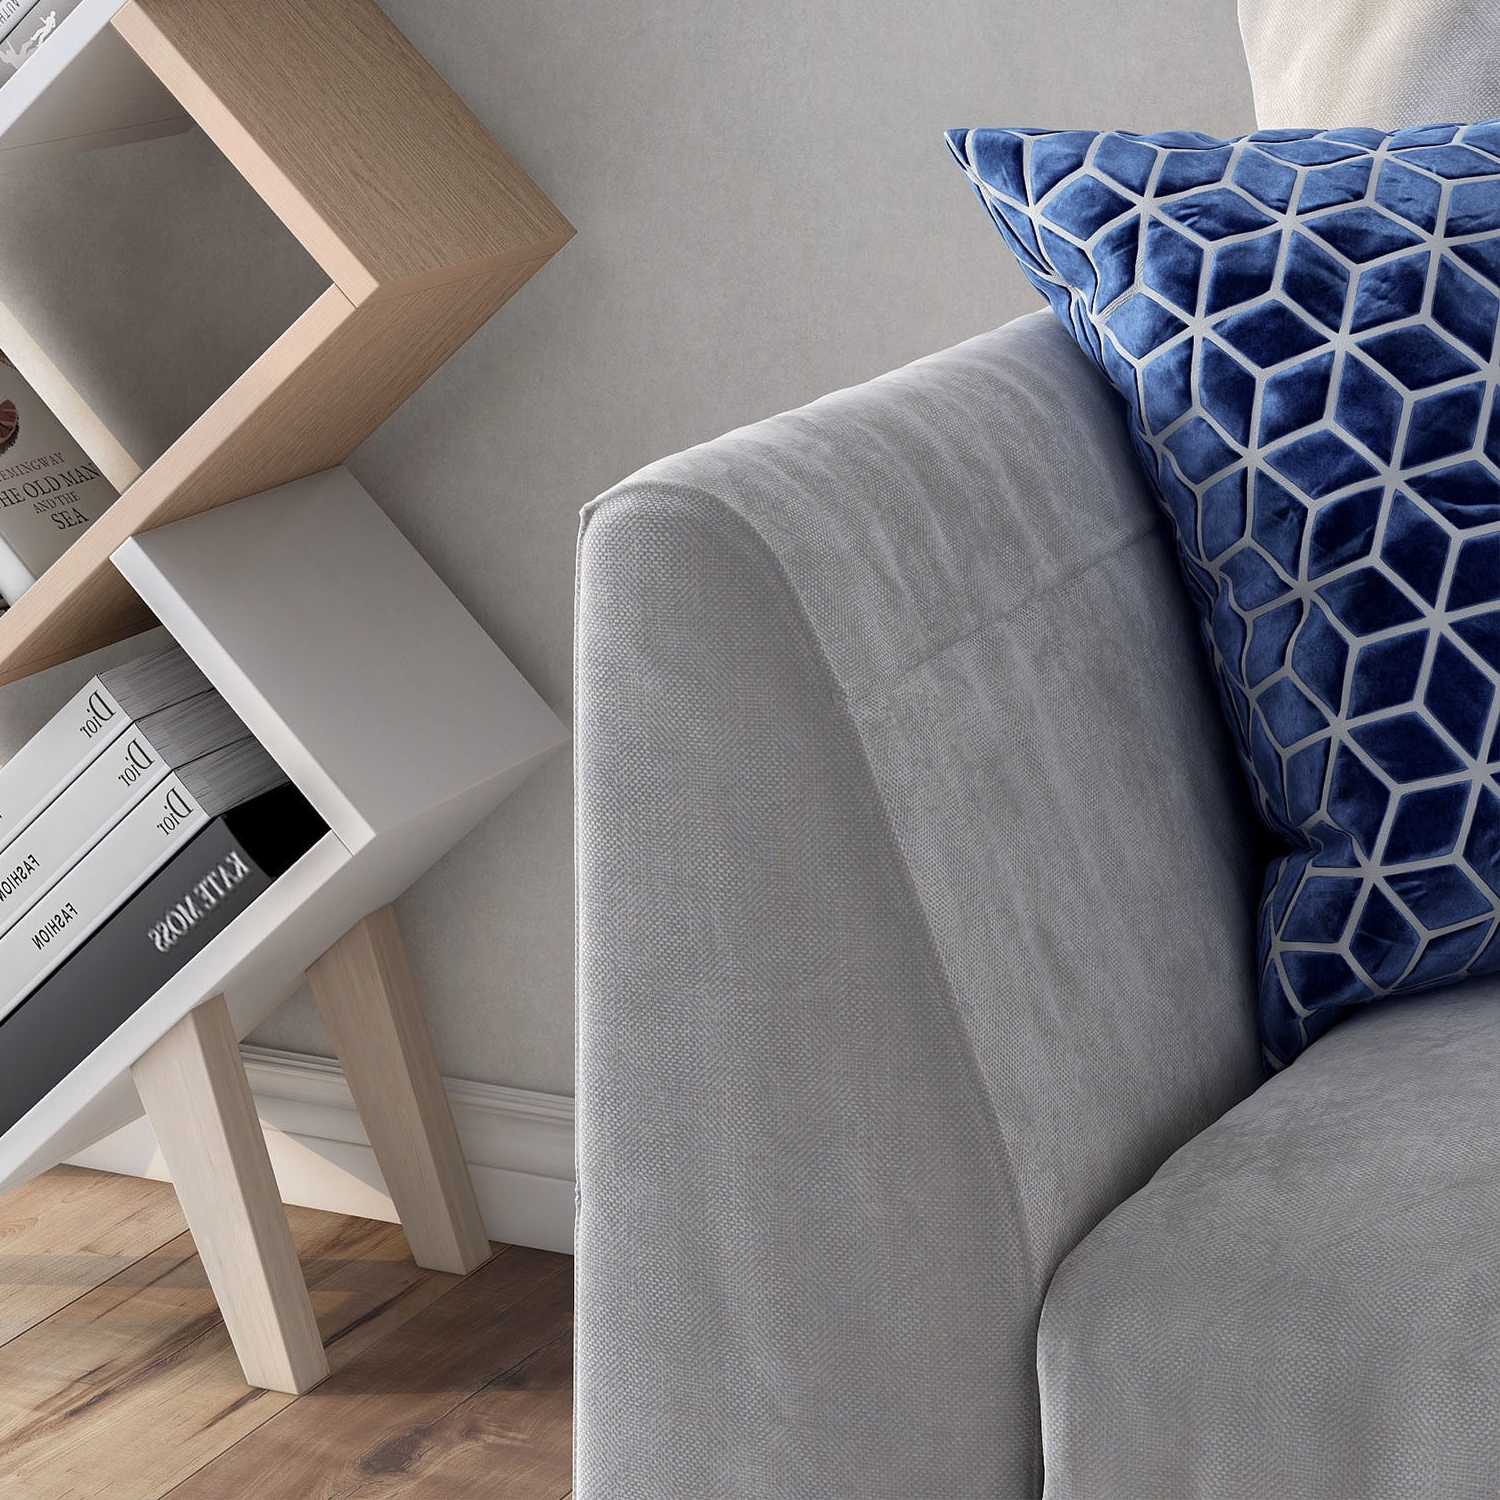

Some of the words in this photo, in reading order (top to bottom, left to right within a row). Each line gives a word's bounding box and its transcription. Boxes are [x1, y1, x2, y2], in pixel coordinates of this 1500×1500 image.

[23, 476, 61, 499] OLD
[64, 462, 100, 487] MAN
[34, 498, 57, 514] AND
[57, 491, 81, 505] THE
[50, 508, 89, 530] SEA
